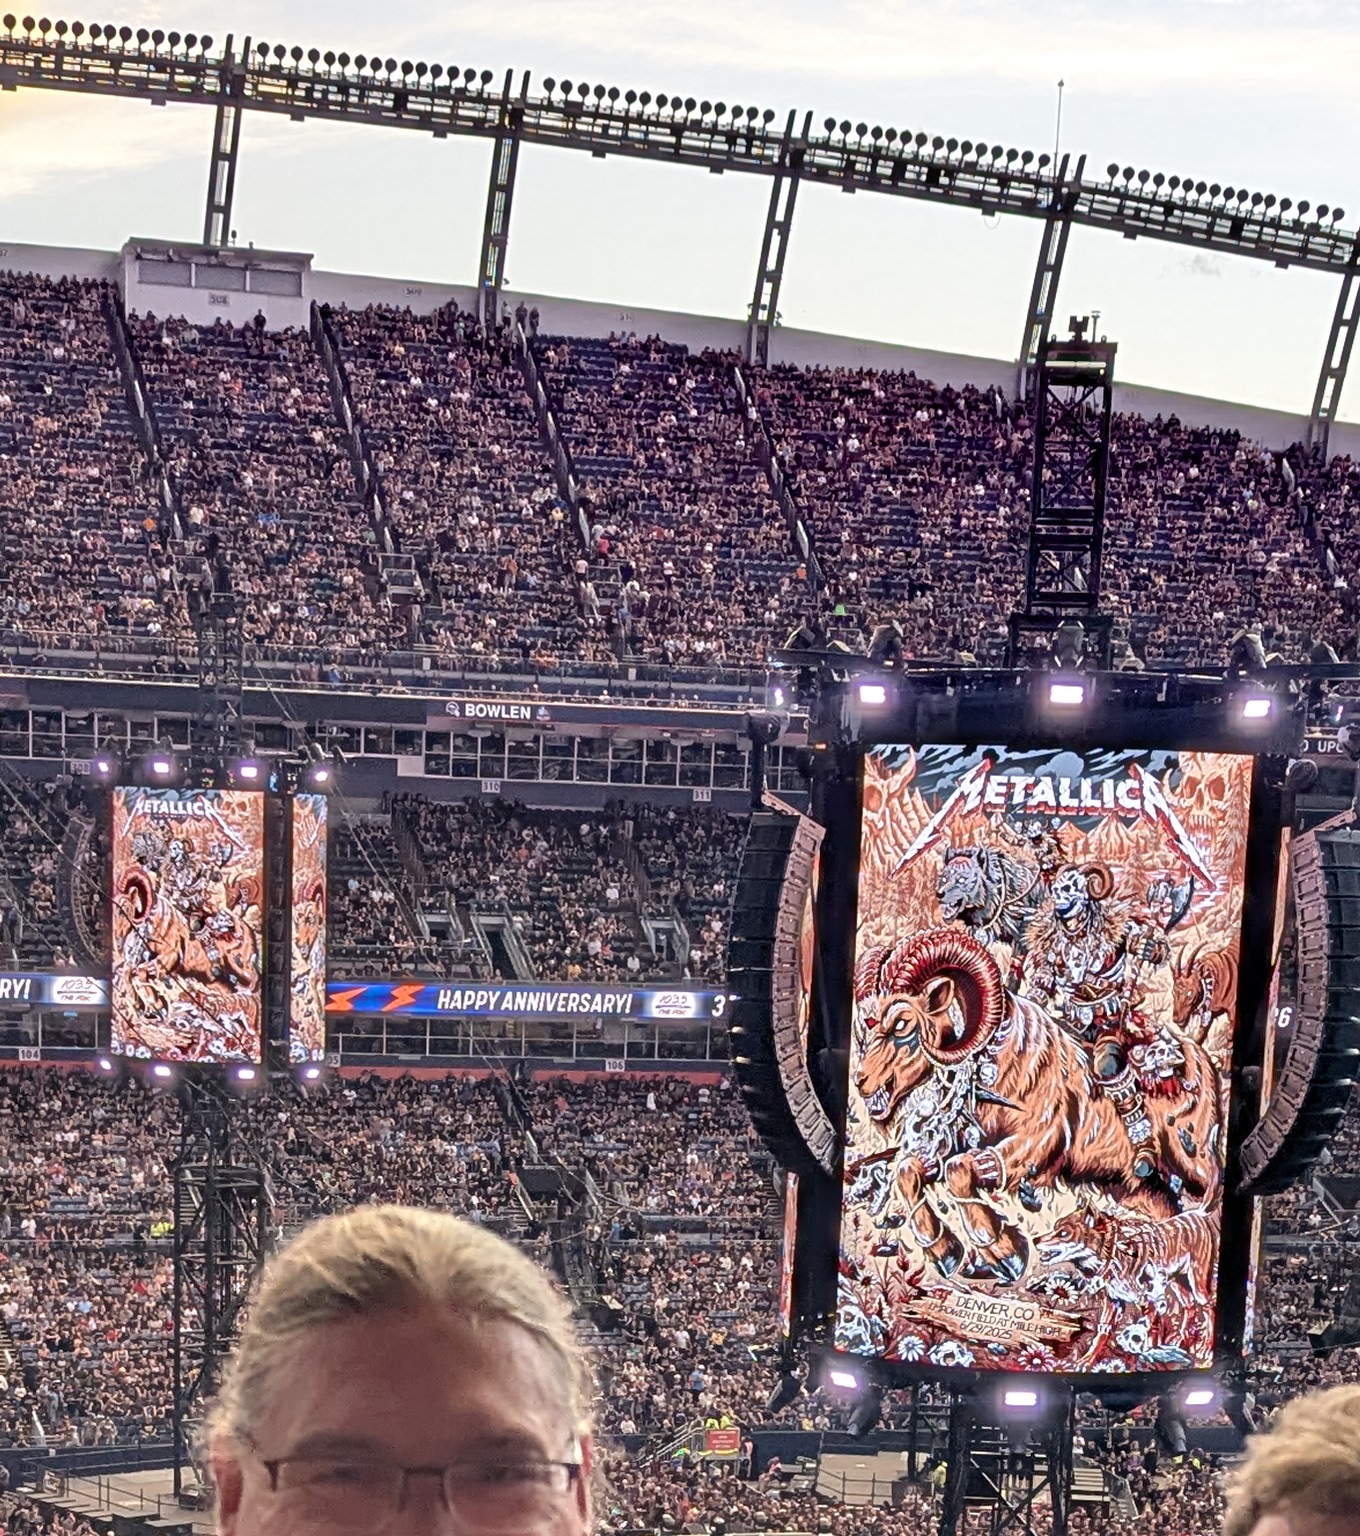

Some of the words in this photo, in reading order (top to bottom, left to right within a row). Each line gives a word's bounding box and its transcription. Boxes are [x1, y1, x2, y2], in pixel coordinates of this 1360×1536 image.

[465, 703, 531, 720] BOWLEN
[437, 988, 501, 1011] HAPPY
[501, 990, 633, 1014] ANNIVERSARY!
[711, 995, 726, 1017] 3
[21, 1049, 39, 1059] 104
[955, 1296, 1011, 1319] DENVER,
[1013, 1304, 1035, 1322] CO
[959, 1320, 1013, 1339] 6/29/2025
